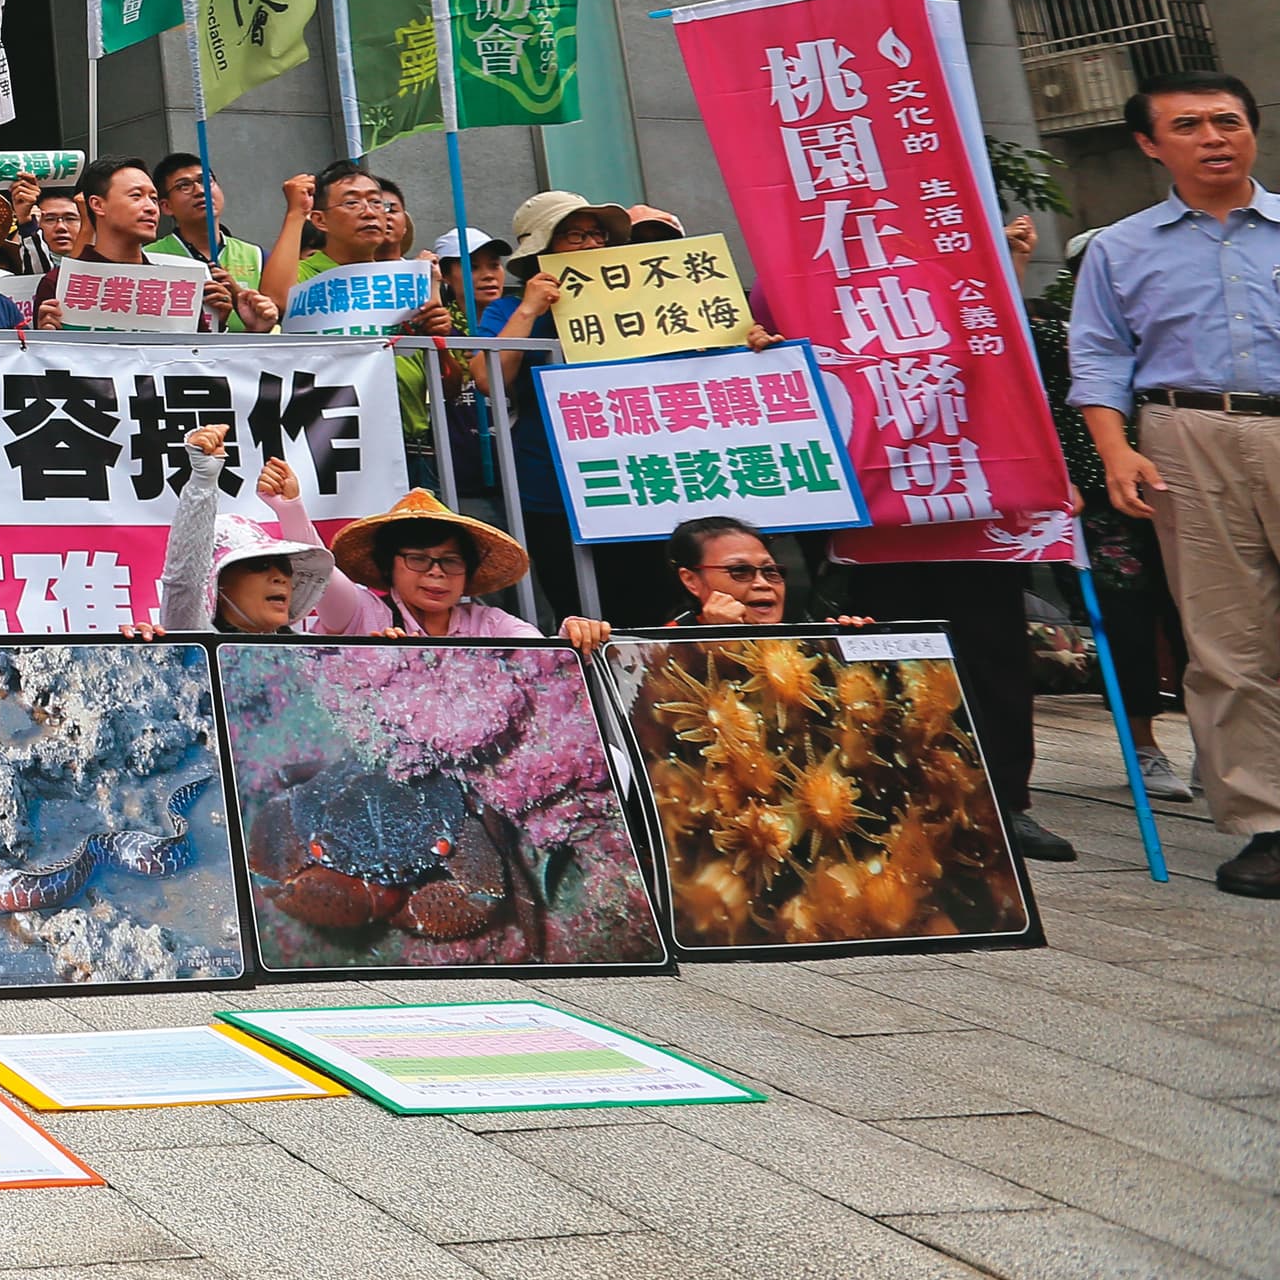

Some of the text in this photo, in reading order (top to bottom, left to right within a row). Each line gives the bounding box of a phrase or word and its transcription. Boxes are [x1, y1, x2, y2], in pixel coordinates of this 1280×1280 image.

[887, 78, 1004, 357] 文化的 生活的 公義的
[63, 272, 198, 319] 專業審查
[558, 250, 729, 299] 今日不救
[759, 36, 1003, 528] 桃園在地聯盟
[568, 295, 741, 347] 明日後悔
[557, 368, 821, 442] 能源要轉型
[576, 438, 843, 509] 三接該遷址
